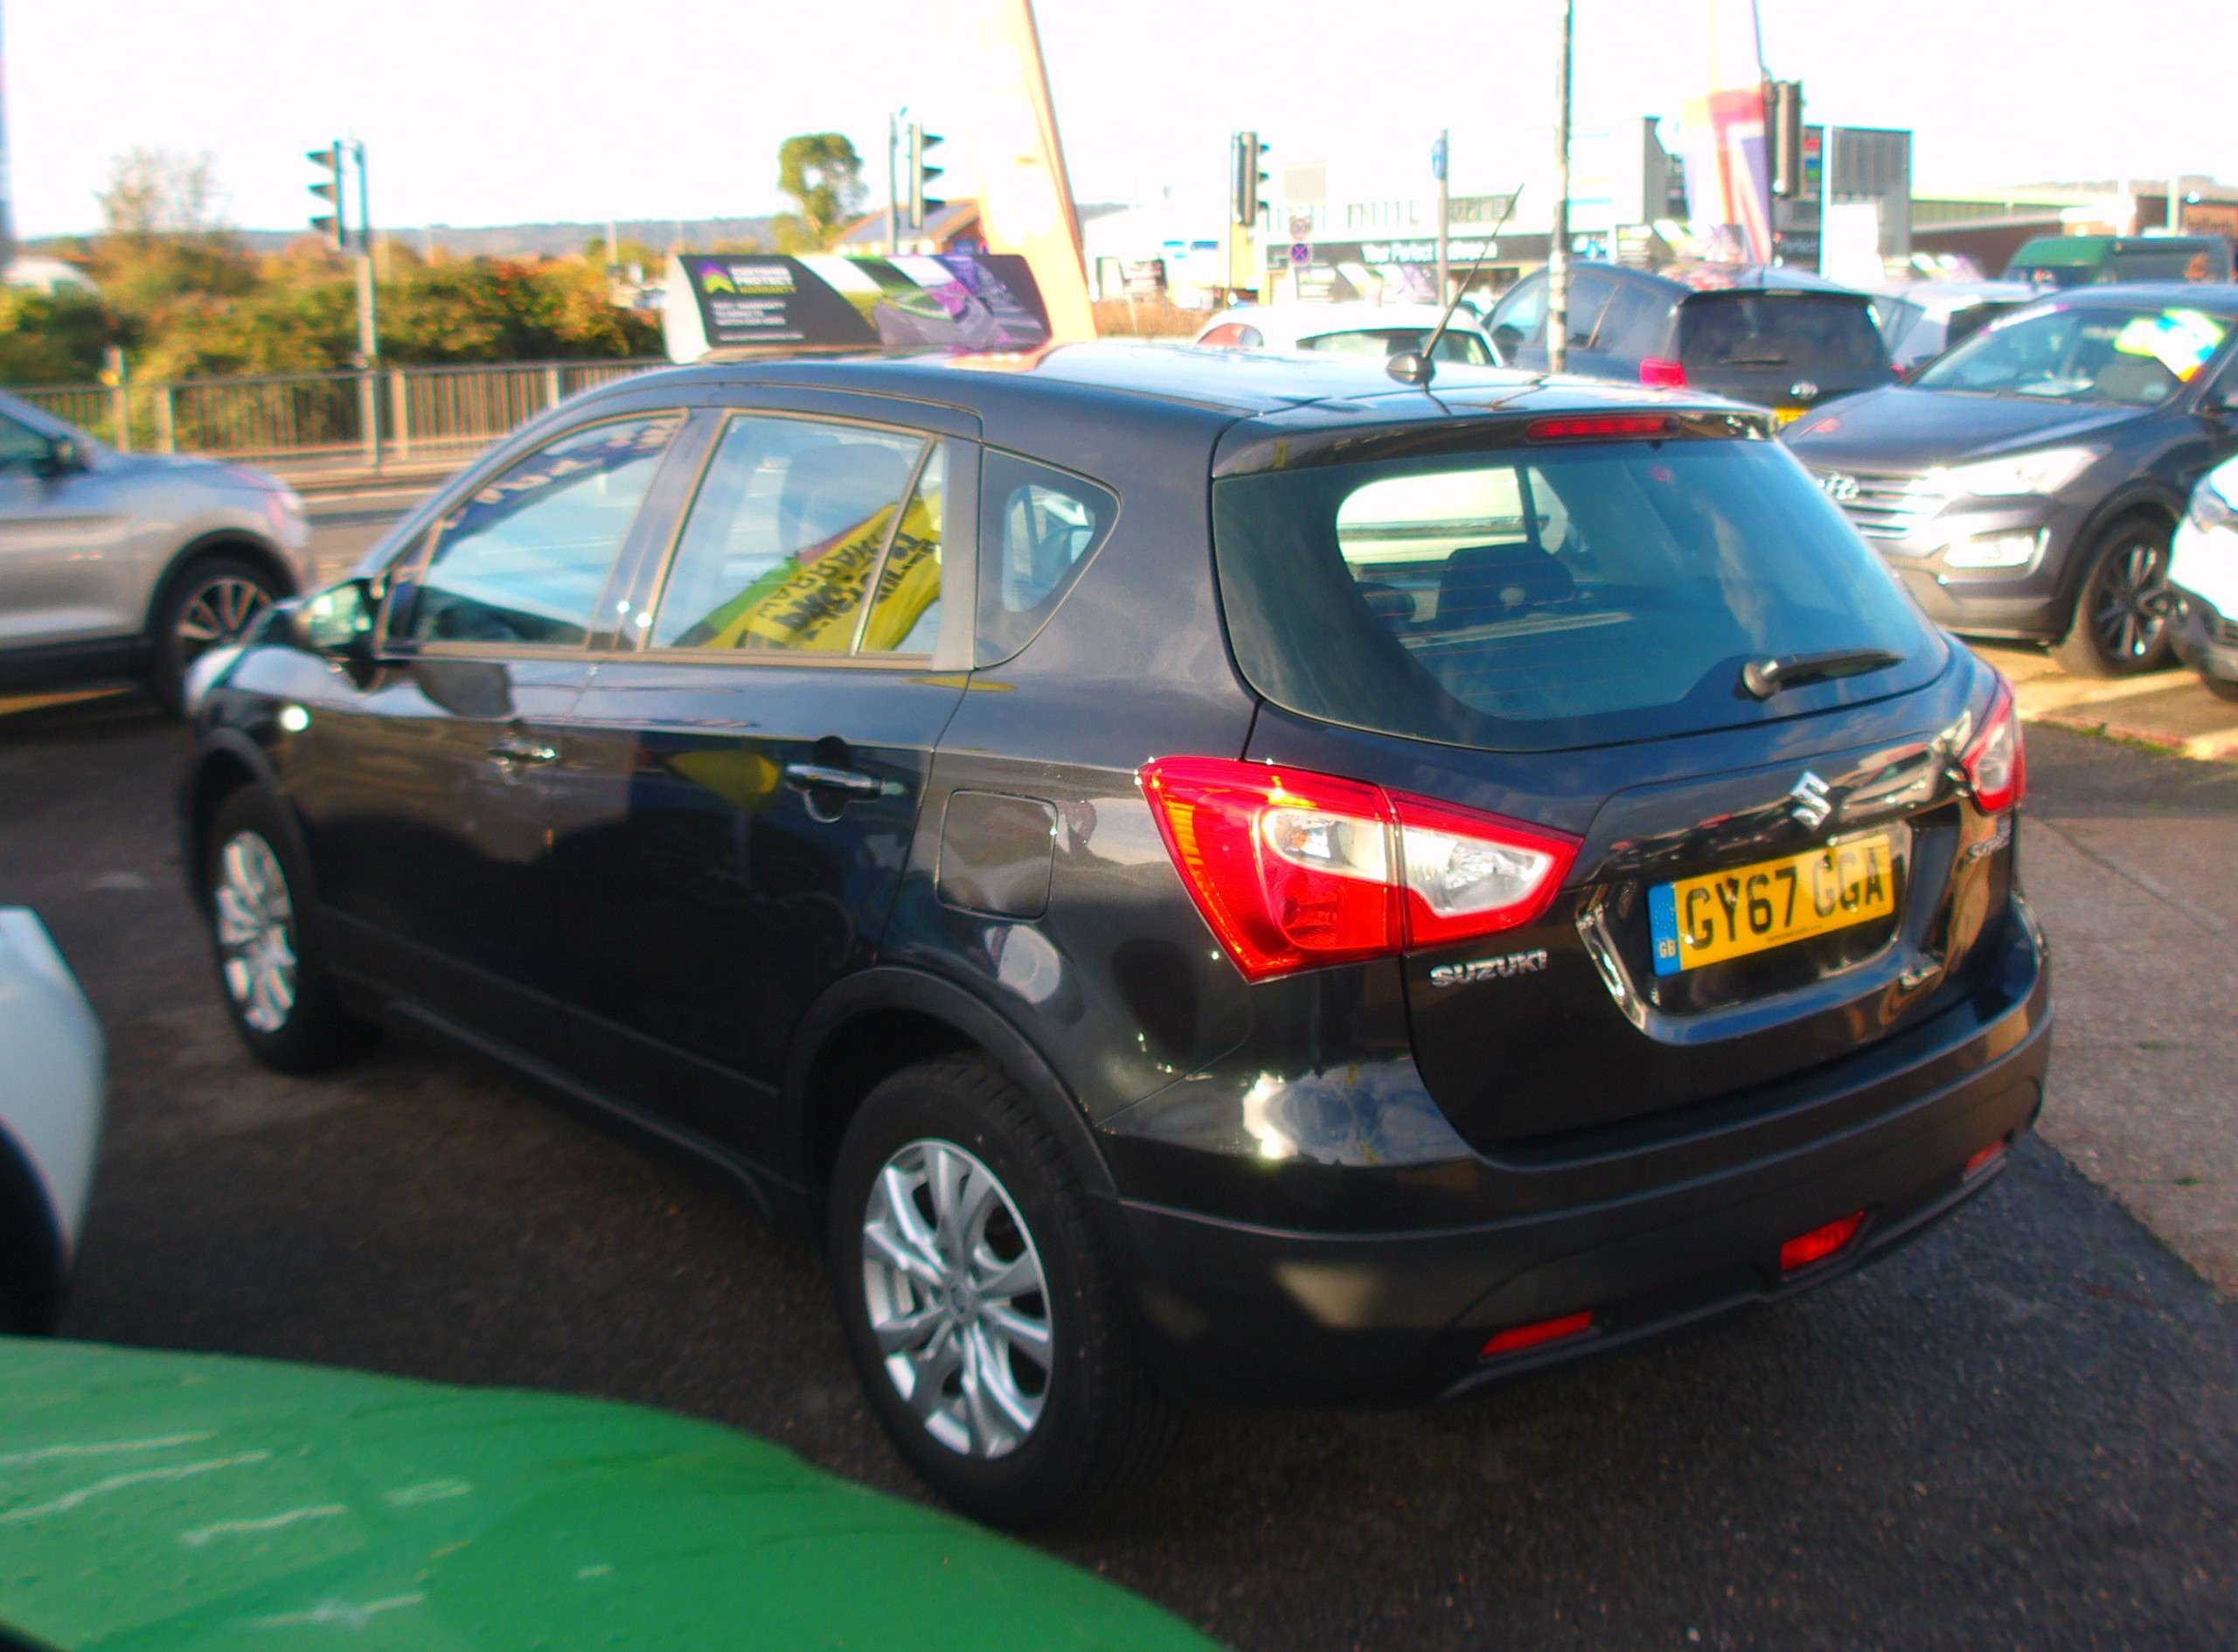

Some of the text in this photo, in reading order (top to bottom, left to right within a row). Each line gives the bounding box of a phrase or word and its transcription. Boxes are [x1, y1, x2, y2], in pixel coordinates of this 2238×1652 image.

[1685, 846, 1884, 951] GY67 CGA
[1430, 948, 1548, 988] SUZUKI
[1658, 940, 1676, 958] GB
